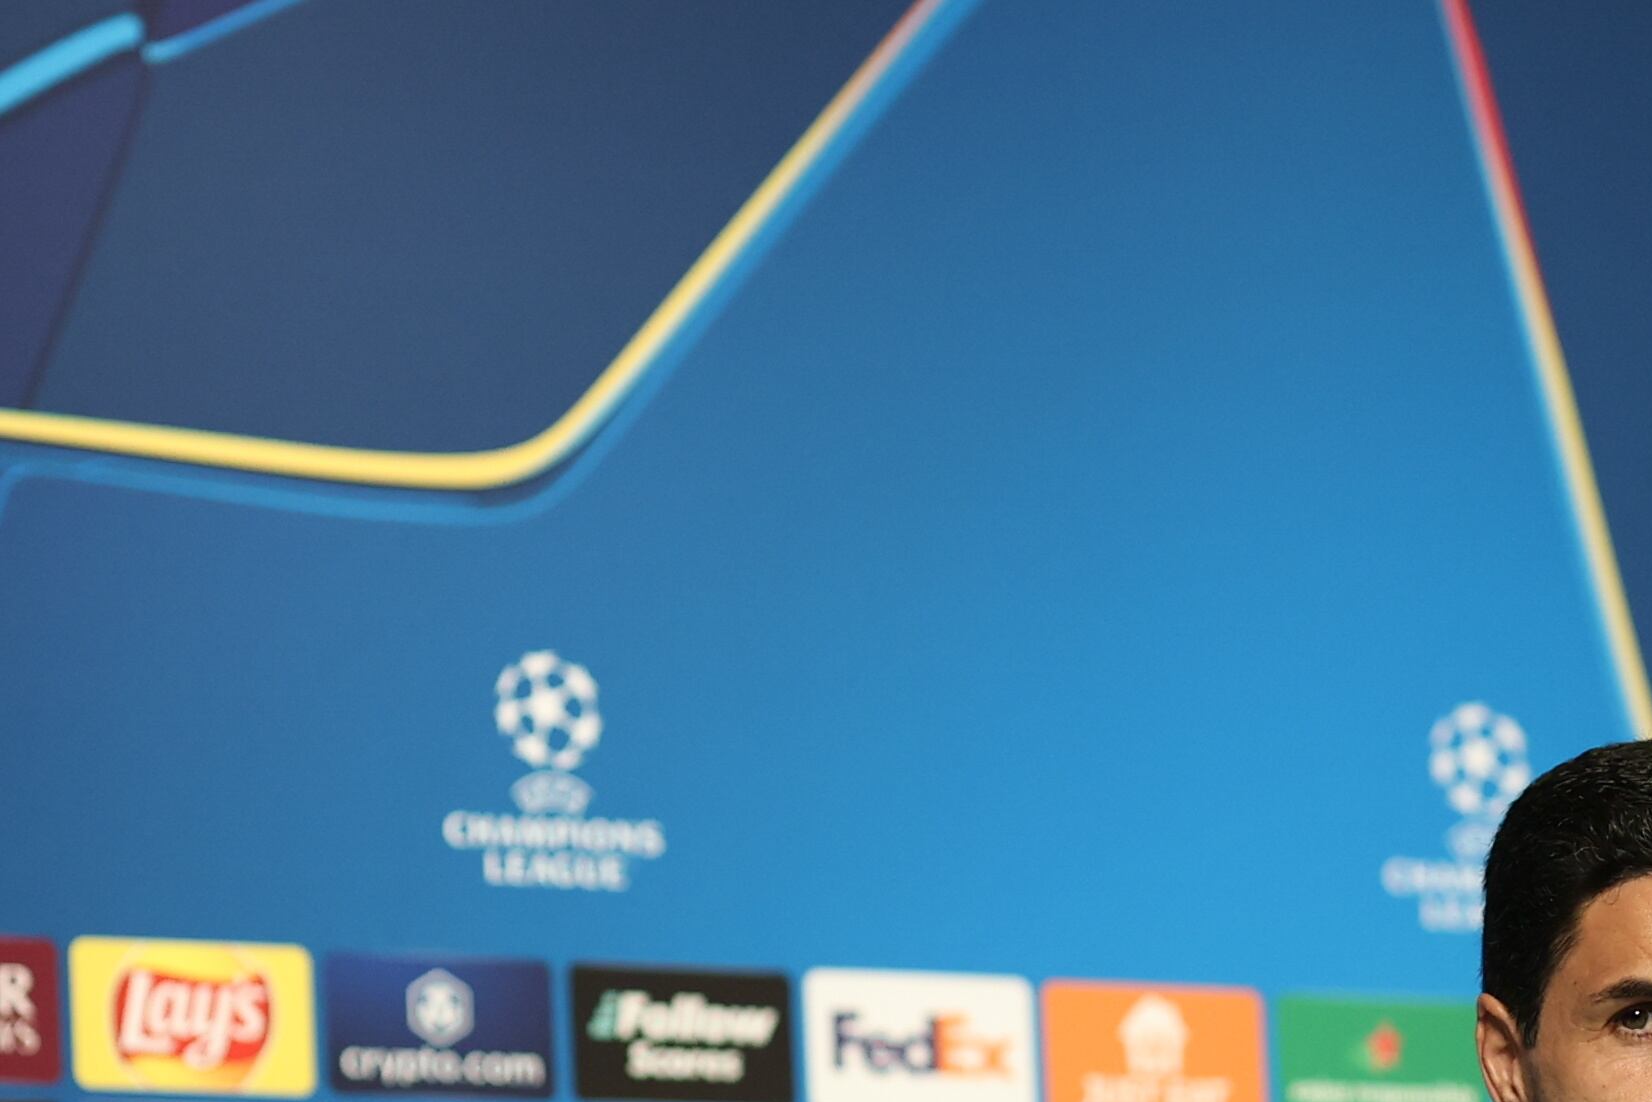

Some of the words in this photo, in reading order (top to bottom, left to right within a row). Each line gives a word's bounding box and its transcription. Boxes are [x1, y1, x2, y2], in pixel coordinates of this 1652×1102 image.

[442, 811, 665, 859] CHAMPIONS
[483, 851, 628, 891] LEAGUE
[117, 967, 267, 1067] Lay's
[340, 1045, 546, 1088] crypto.com
[832, 1010, 1012, 1077] FedEx
